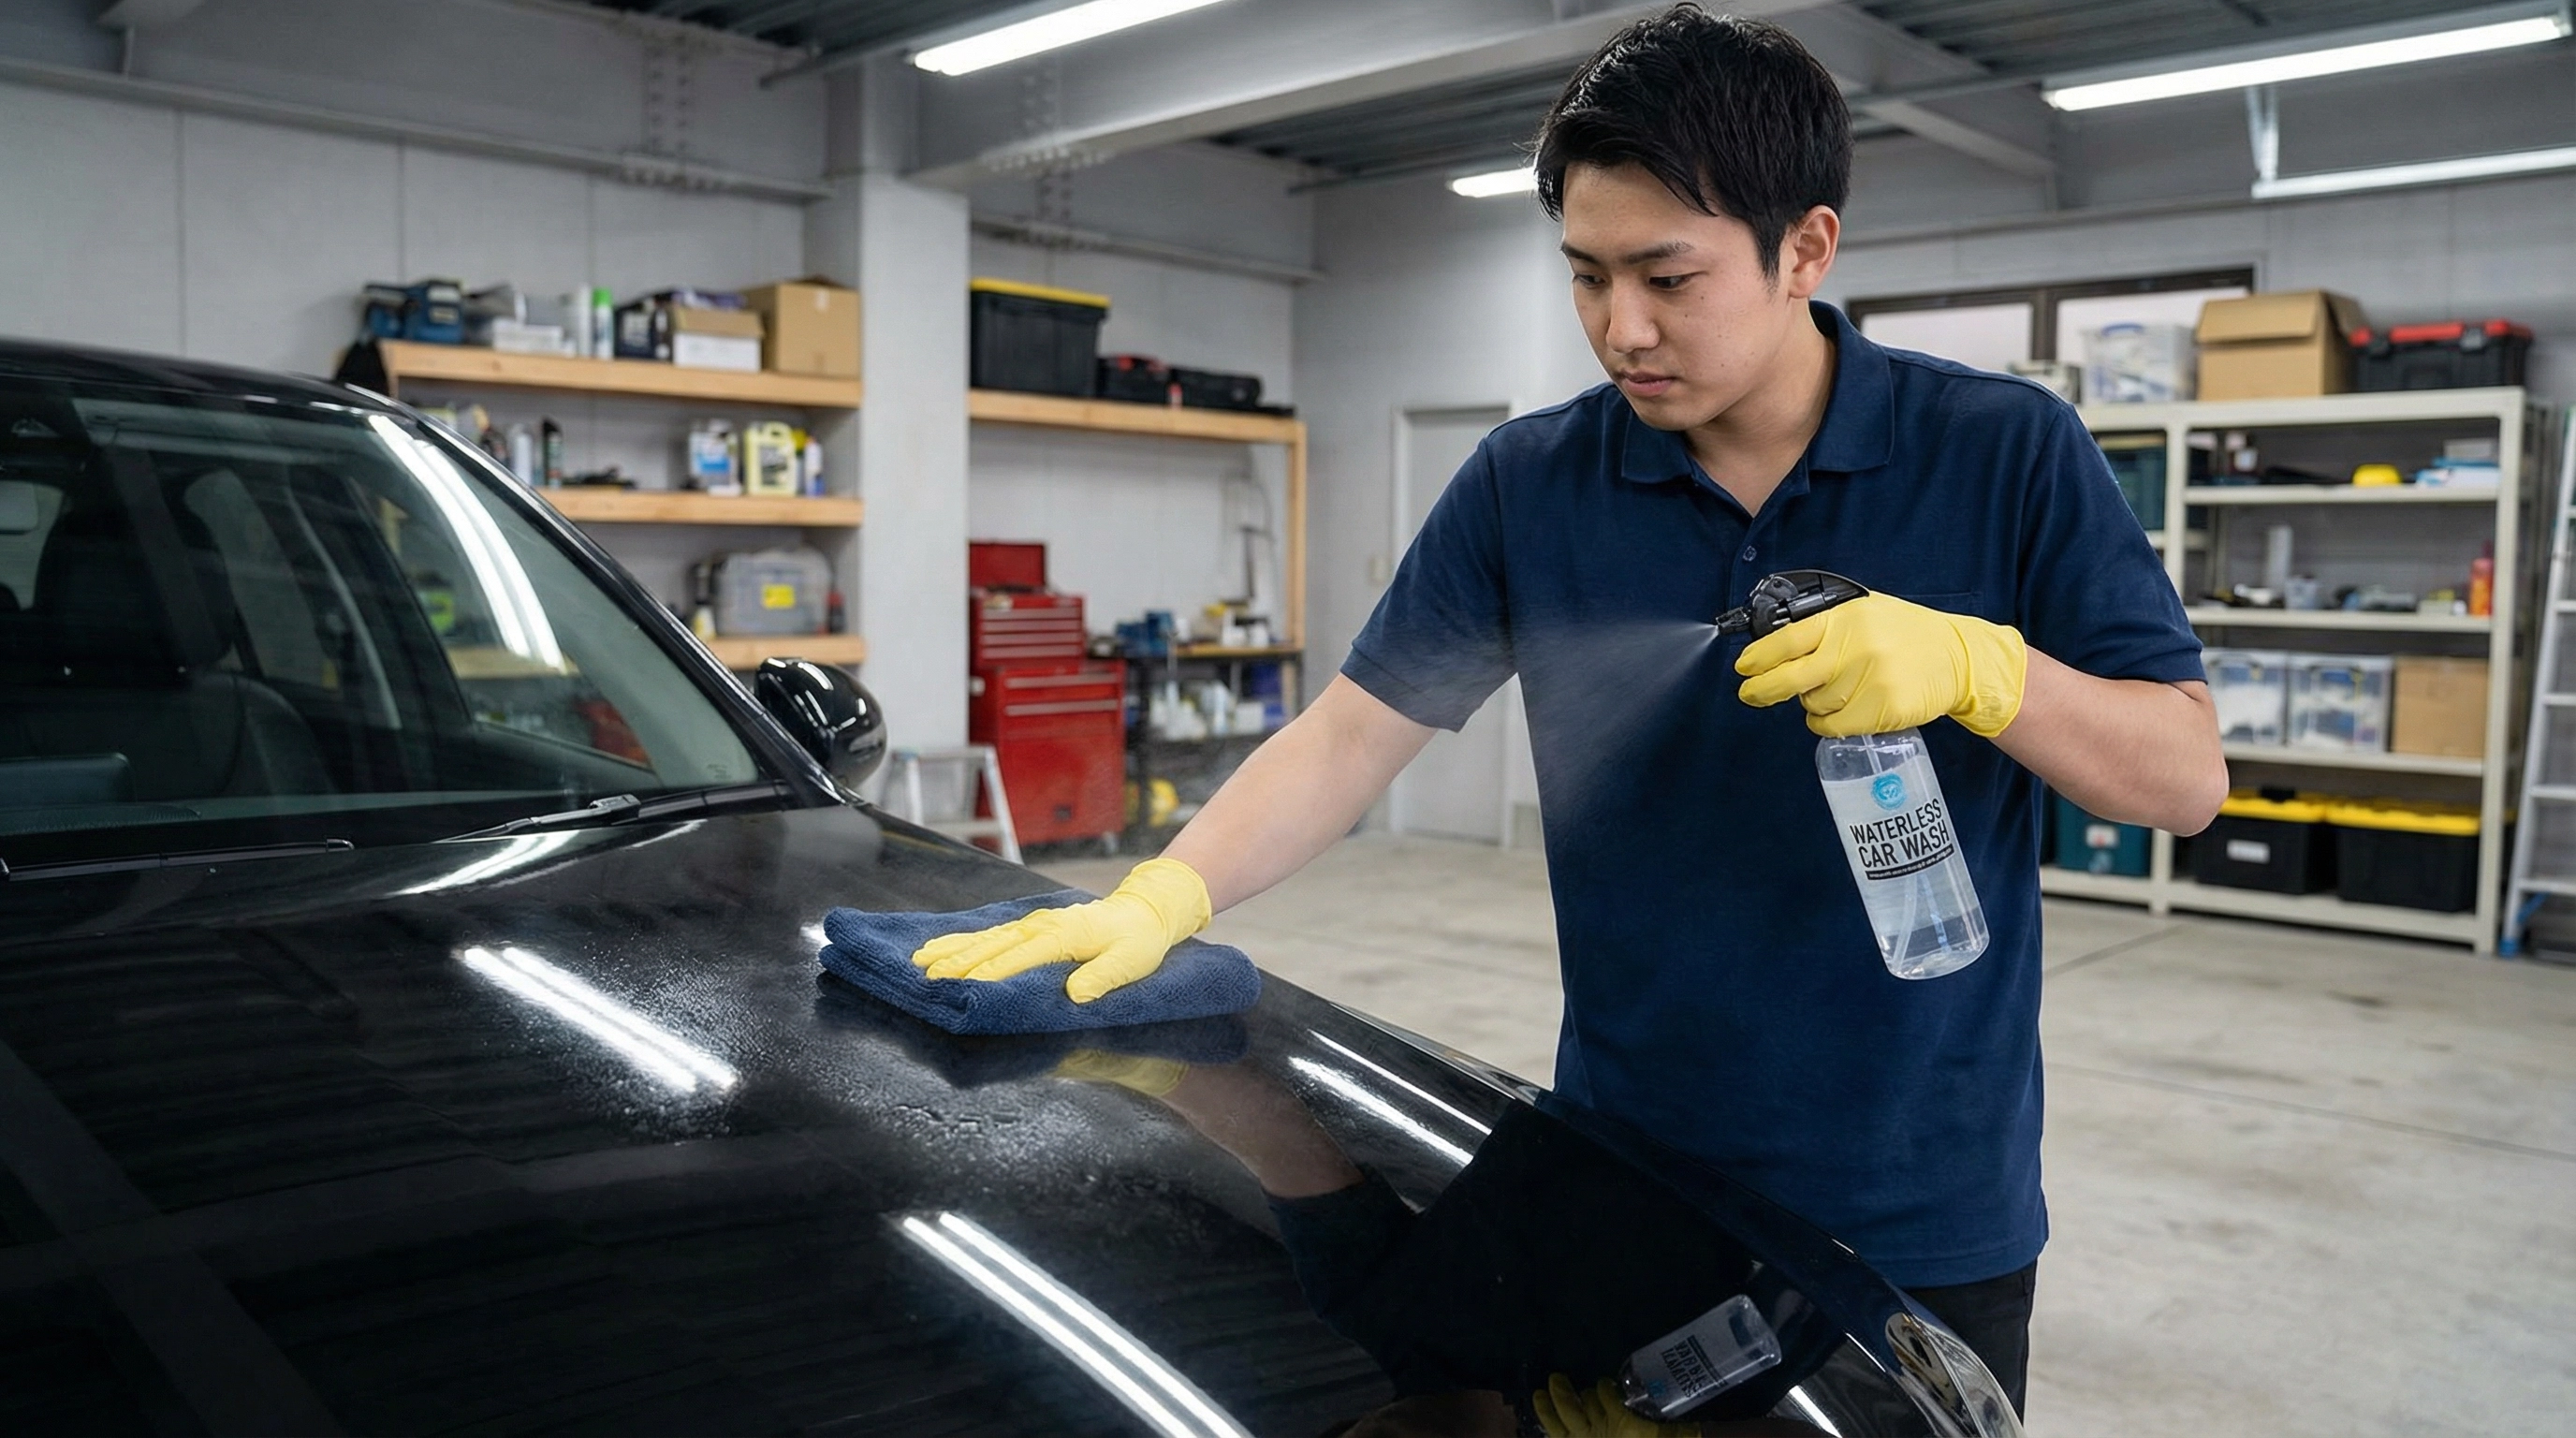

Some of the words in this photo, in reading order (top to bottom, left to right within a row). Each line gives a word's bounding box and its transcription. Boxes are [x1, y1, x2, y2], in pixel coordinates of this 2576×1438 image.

[1850, 799, 1942, 844] WATERLESS
[1858, 843, 1898, 869] CAR
[1899, 821, 1950, 860] WASH
